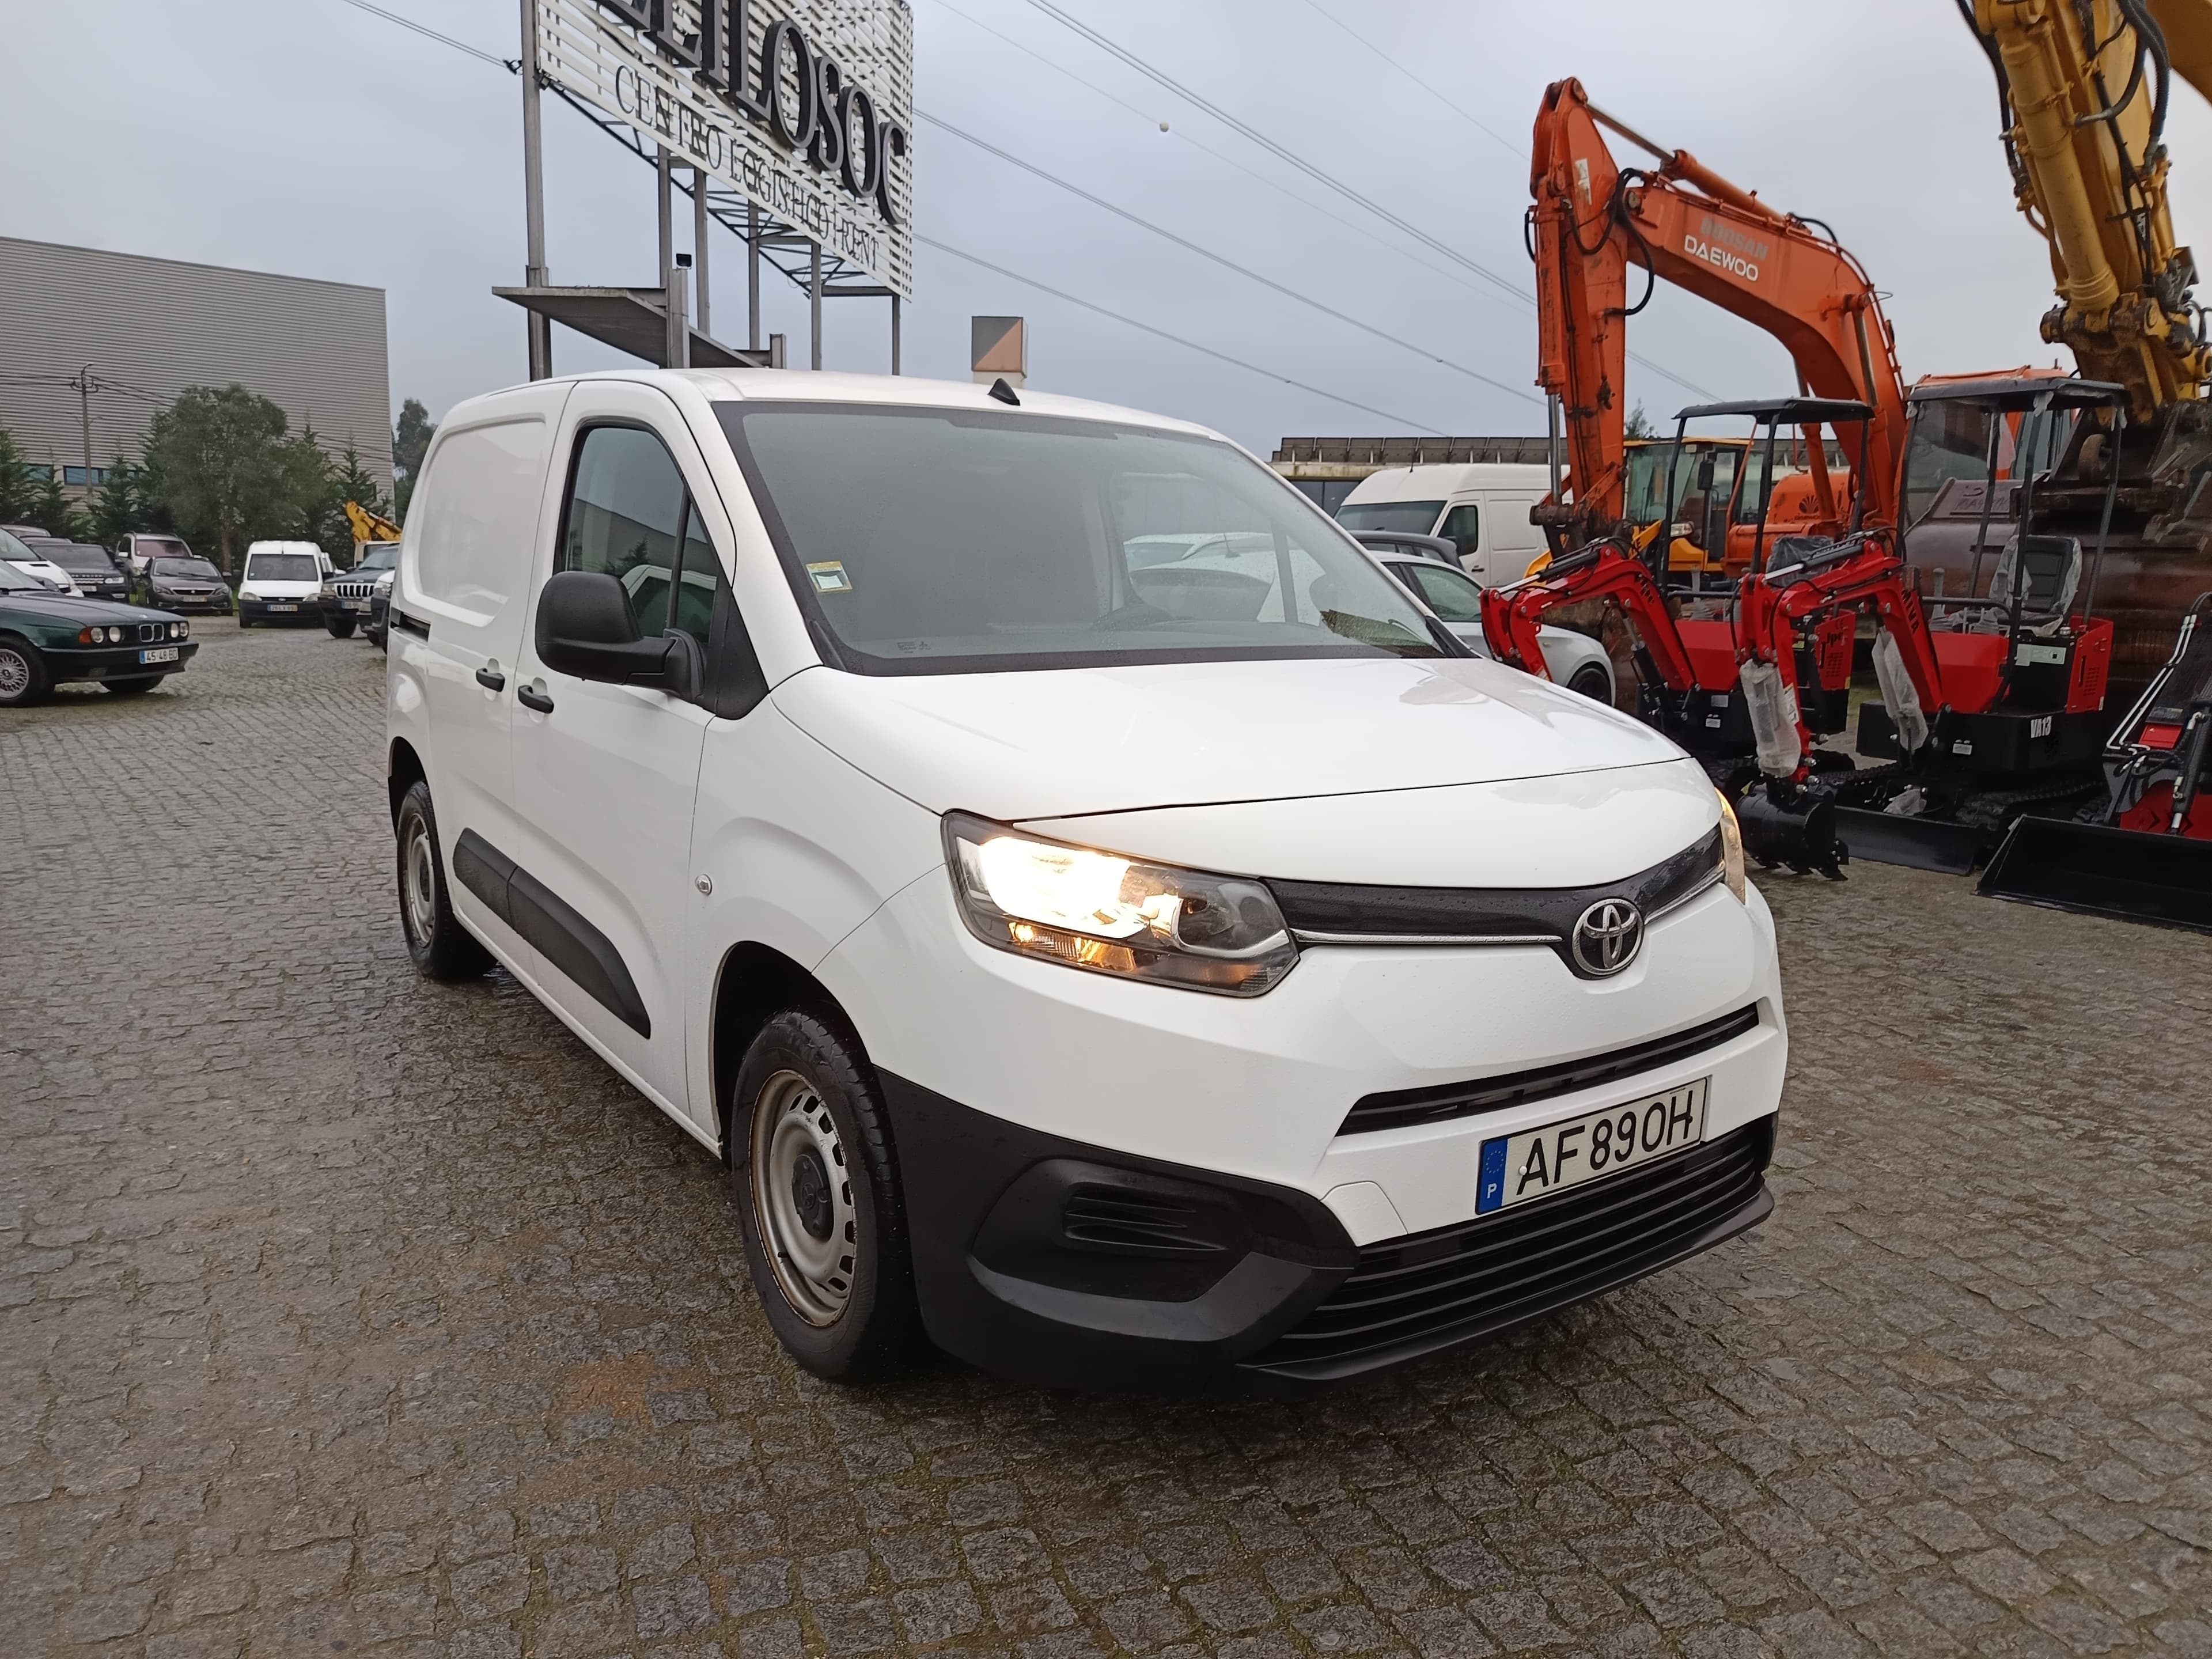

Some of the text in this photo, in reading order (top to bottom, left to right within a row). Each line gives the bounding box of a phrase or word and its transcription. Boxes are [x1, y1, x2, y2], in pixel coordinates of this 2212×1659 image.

[1684, 234, 1759, 282] DAEWOO
[2030, 715, 2052, 738] VA13
[1487, 1183, 1498, 1199] P
